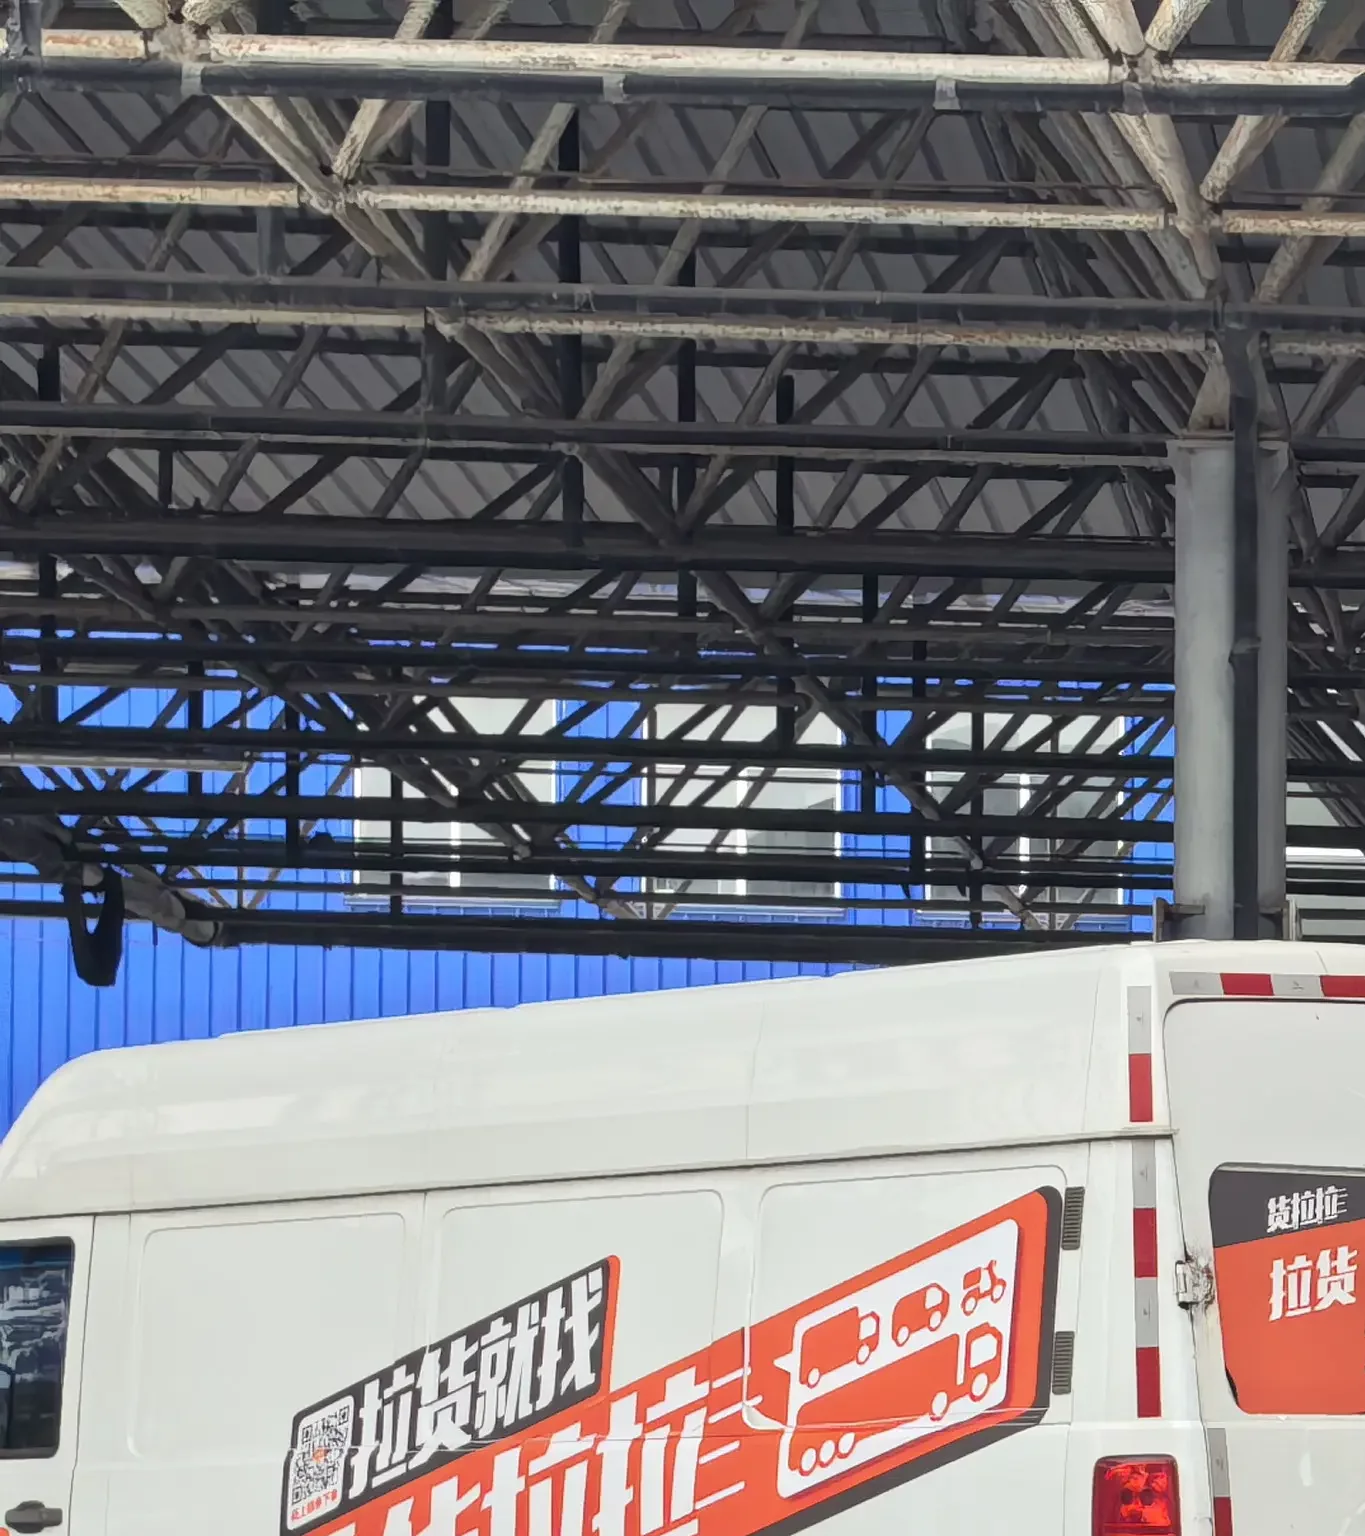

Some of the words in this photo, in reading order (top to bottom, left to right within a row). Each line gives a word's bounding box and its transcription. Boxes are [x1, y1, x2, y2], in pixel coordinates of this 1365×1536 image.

[1266, 1185, 1348, 1234] 货拉拉
[1268, 1246, 1357, 1322] 拉货
[347, 1267, 602, 1499] 拉货就找
